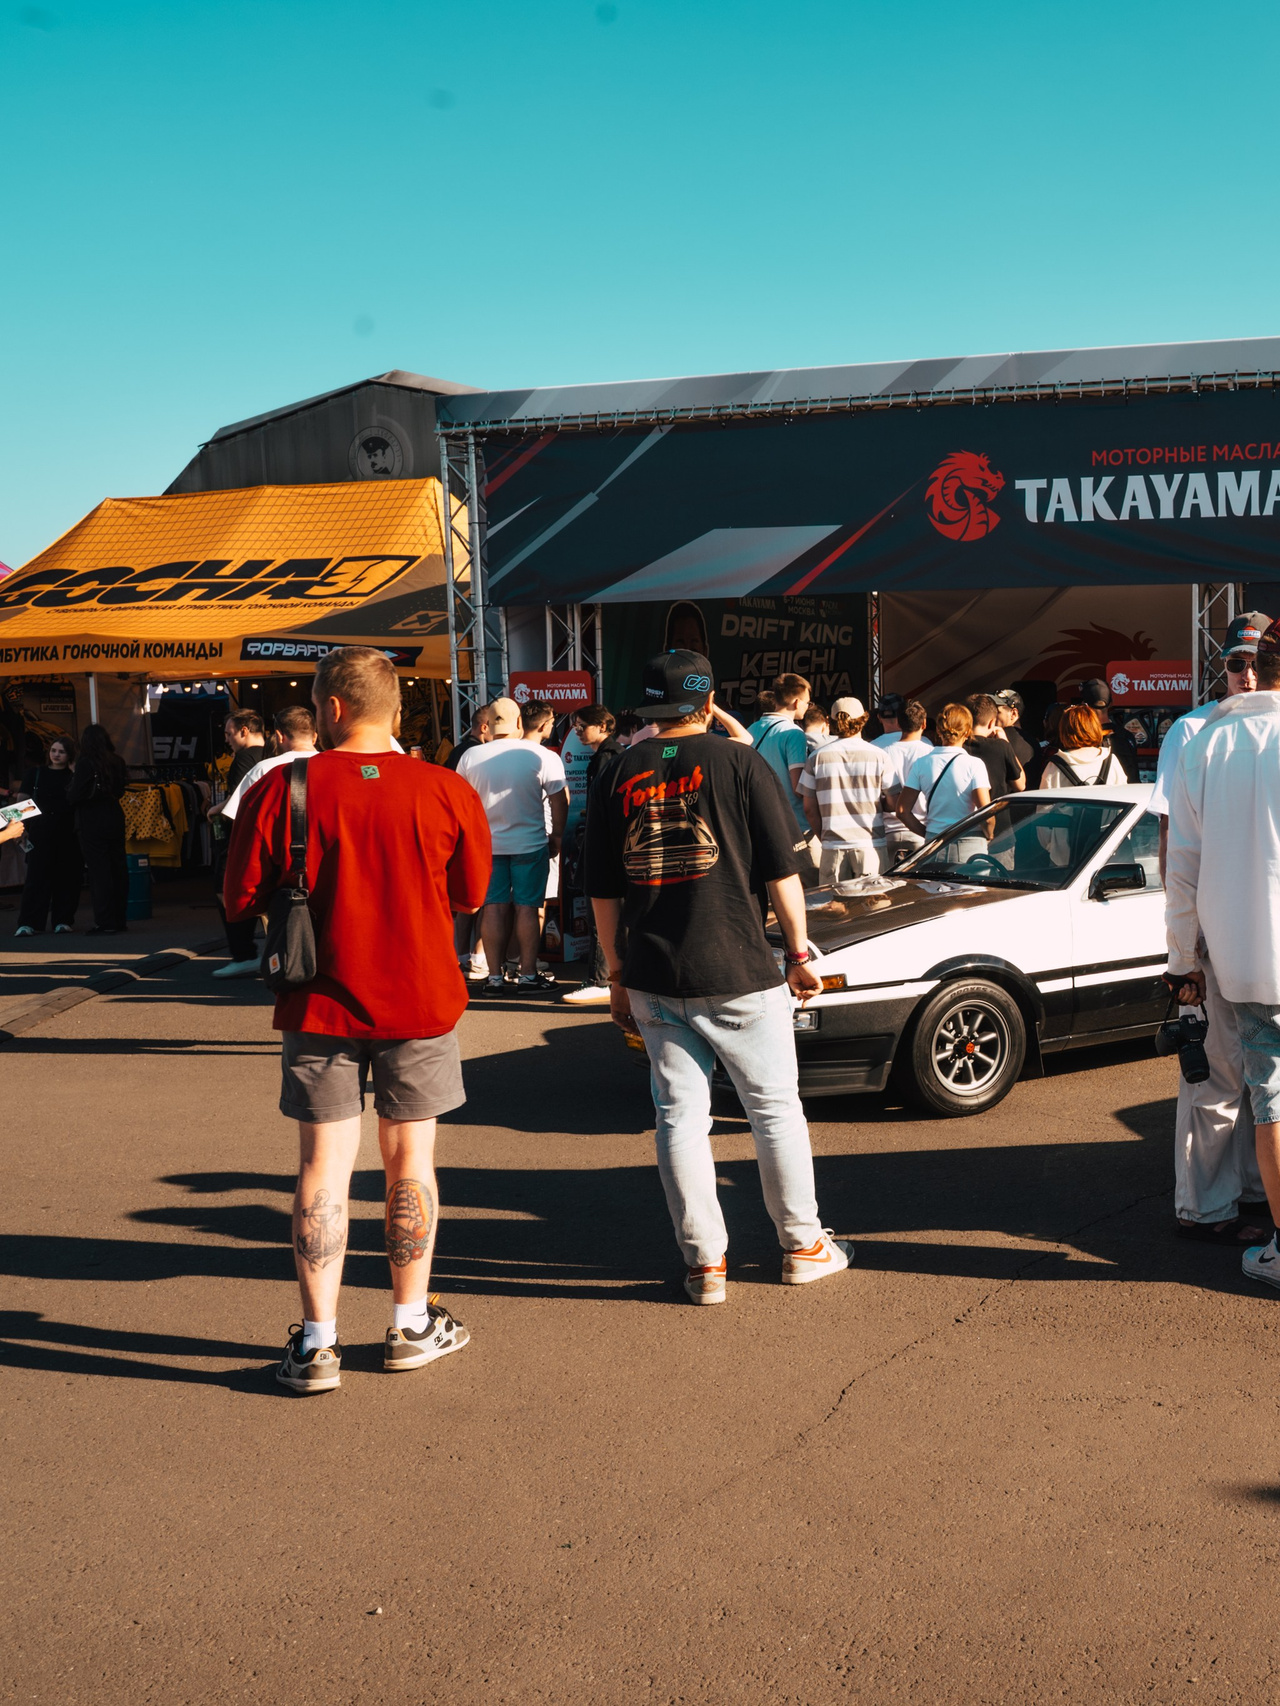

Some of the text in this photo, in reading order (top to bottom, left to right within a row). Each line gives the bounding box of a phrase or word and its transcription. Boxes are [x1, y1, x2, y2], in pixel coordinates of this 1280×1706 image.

[1091, 446, 1207, 466] МОТОРНЫЕ
[788, 605, 816, 617] МОСКВА
[720, 613, 854, 646] DRIFT KING
[63, 640, 140, 660] ГОНОЧНОЙ
[143, 641, 224, 661] КОМАНДЫ
[740, 647, 836, 678] KEIICHI
[532, 689, 588, 700] TAKAYAMA
